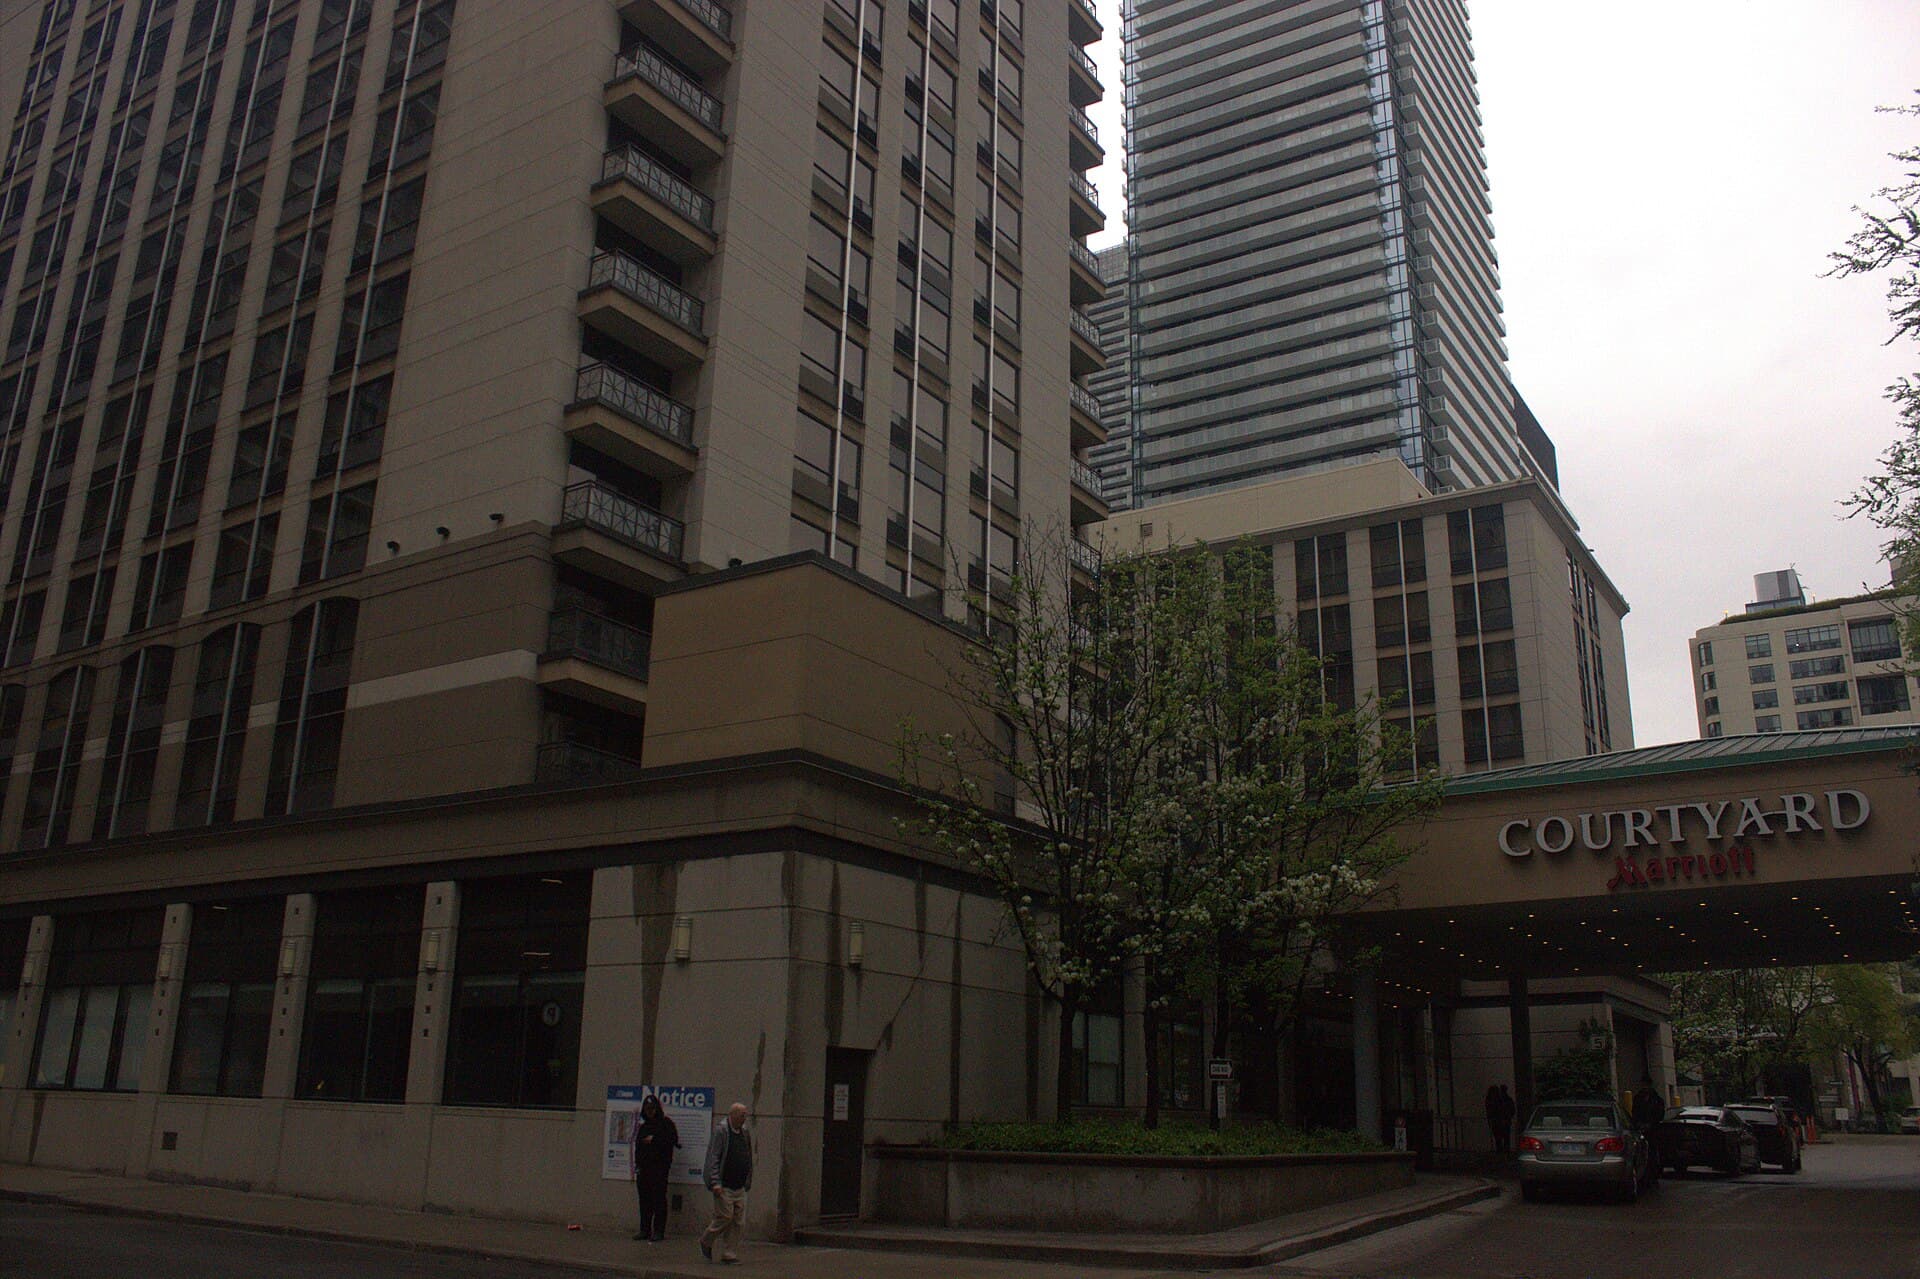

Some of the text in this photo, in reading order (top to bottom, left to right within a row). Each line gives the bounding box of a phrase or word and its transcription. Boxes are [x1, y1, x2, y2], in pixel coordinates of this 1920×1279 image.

[1497, 788, 1871, 858] COURTYARD
[1606, 843, 1757, 890] Marriott
[641, 1085, 706, 1108] Notice
